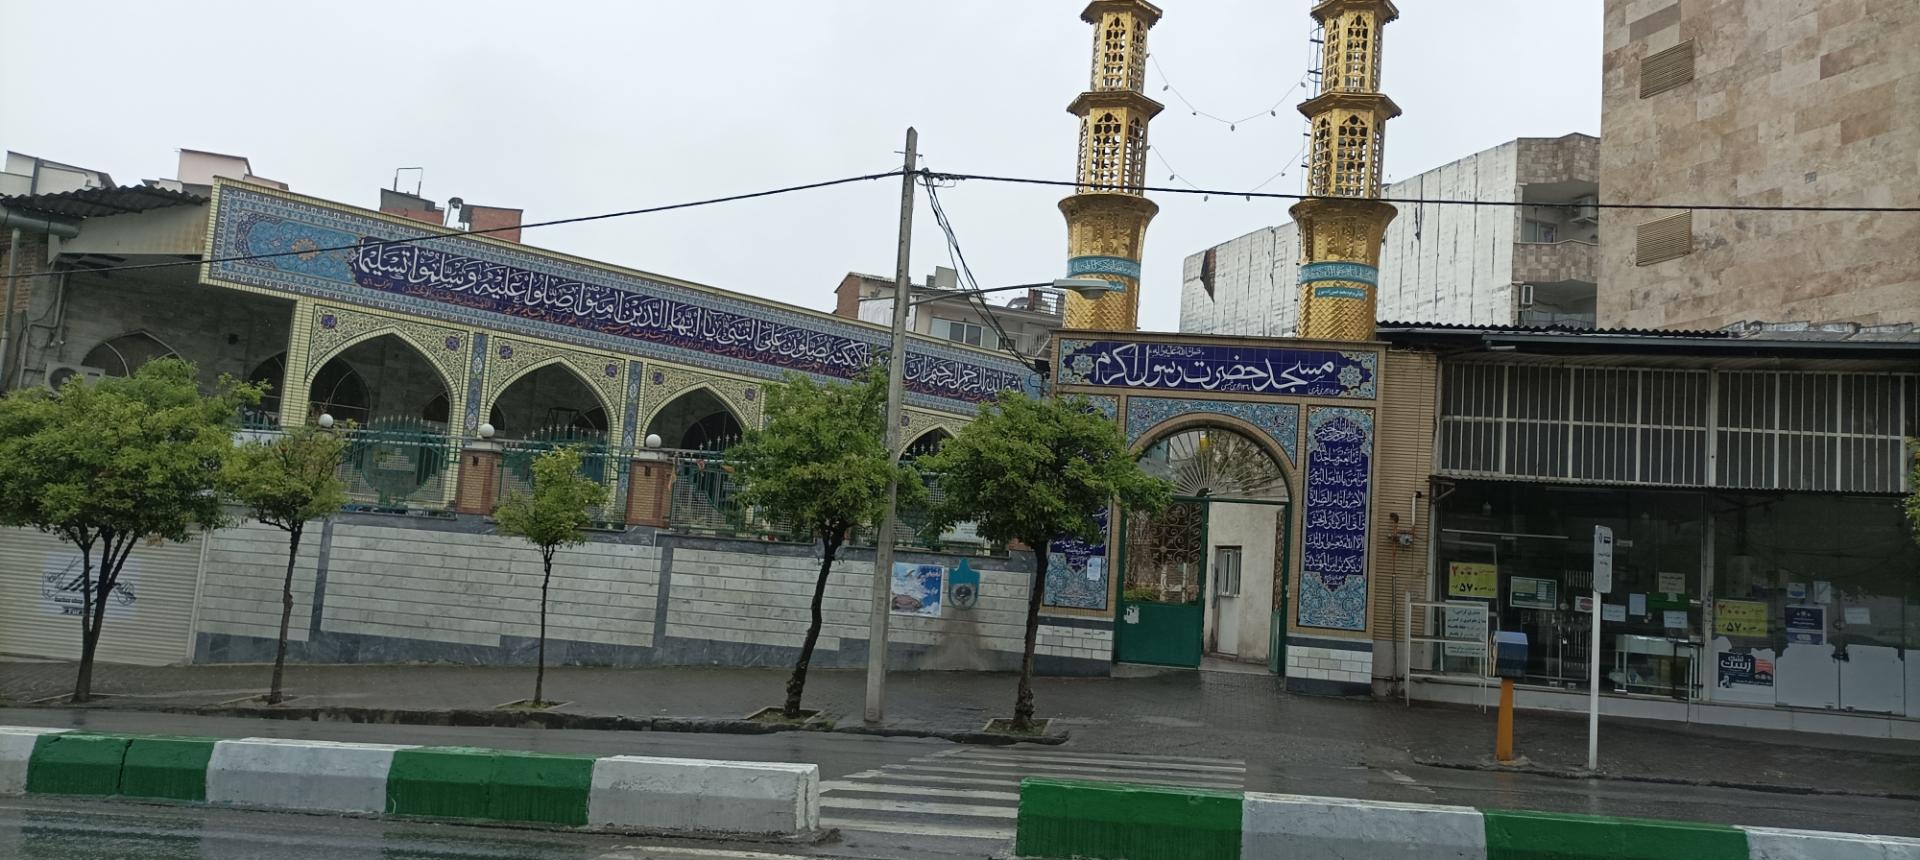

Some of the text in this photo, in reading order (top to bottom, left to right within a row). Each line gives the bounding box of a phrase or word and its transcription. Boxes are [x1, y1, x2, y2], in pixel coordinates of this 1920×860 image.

[1095, 343, 1335, 393] مسجد حضرت رسول اکرم
